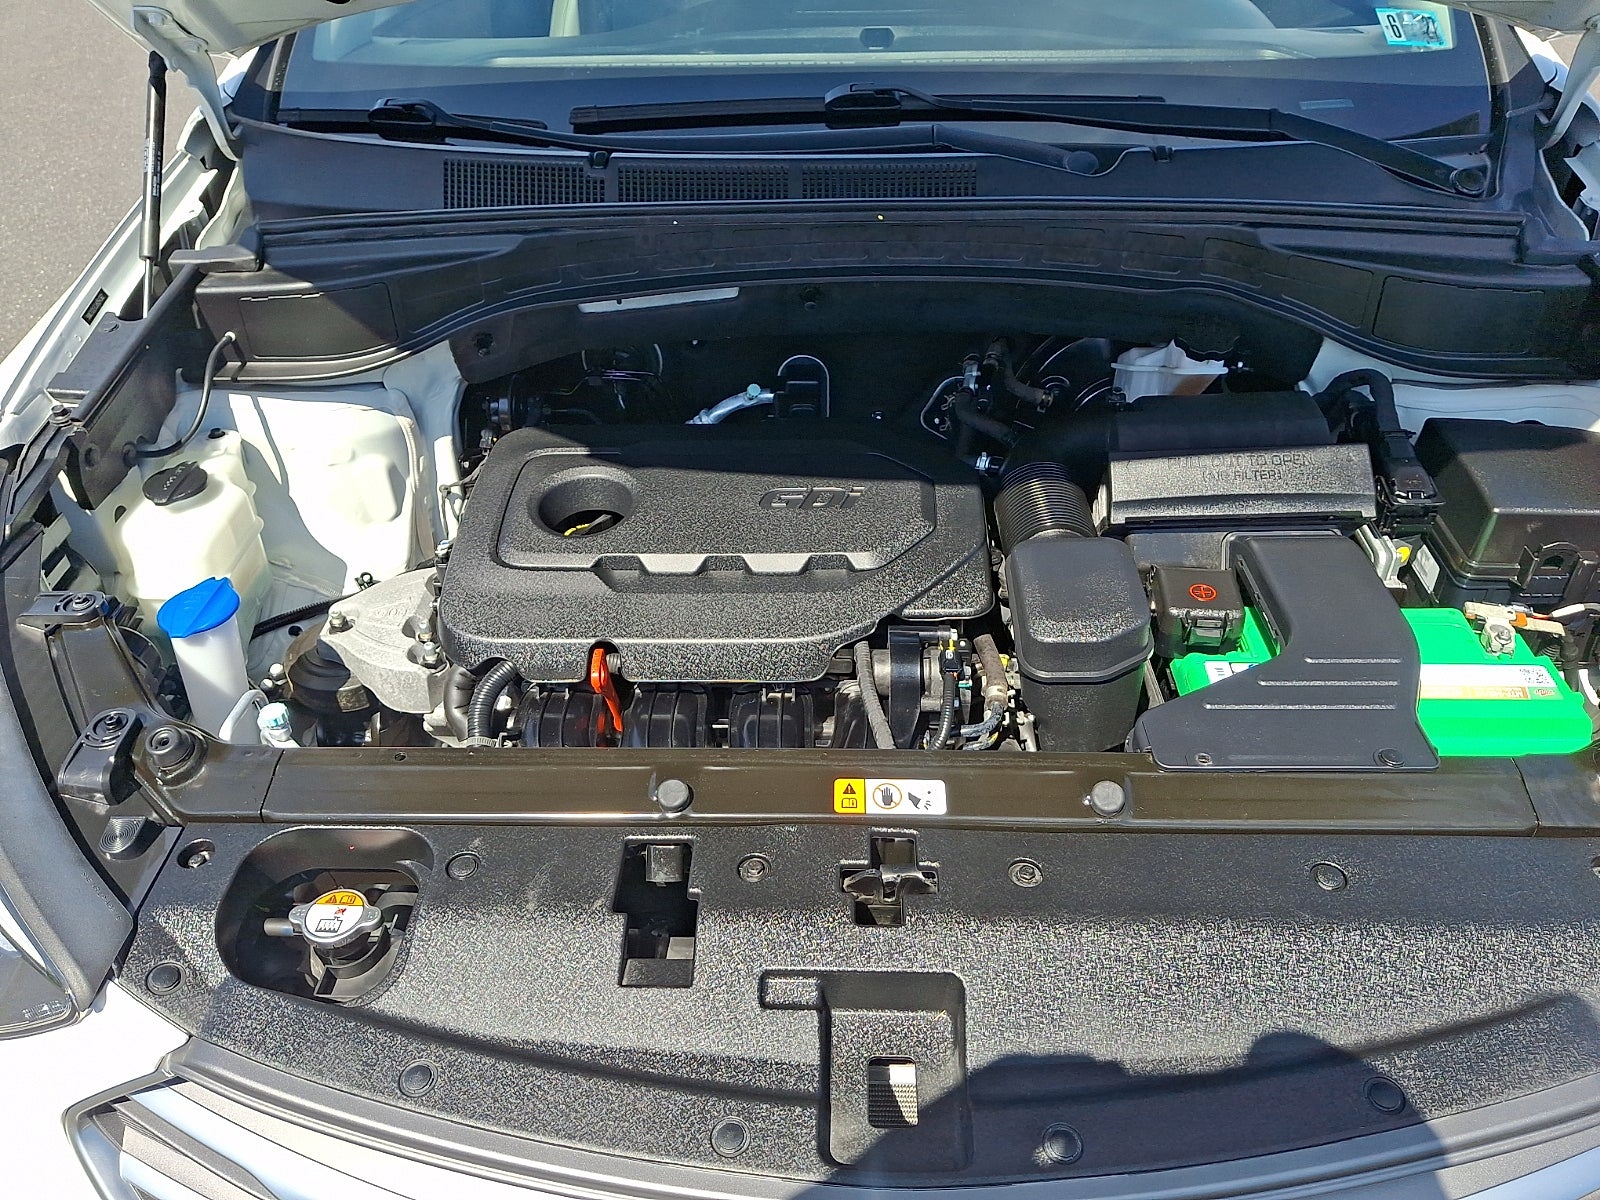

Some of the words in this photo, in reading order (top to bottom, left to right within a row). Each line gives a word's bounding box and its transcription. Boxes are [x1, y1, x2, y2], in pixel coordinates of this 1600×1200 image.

[1386, 14, 1402, 38] 6
[1247, 454, 1267, 466] TO
[1271, 453, 1314, 466] OPEN
